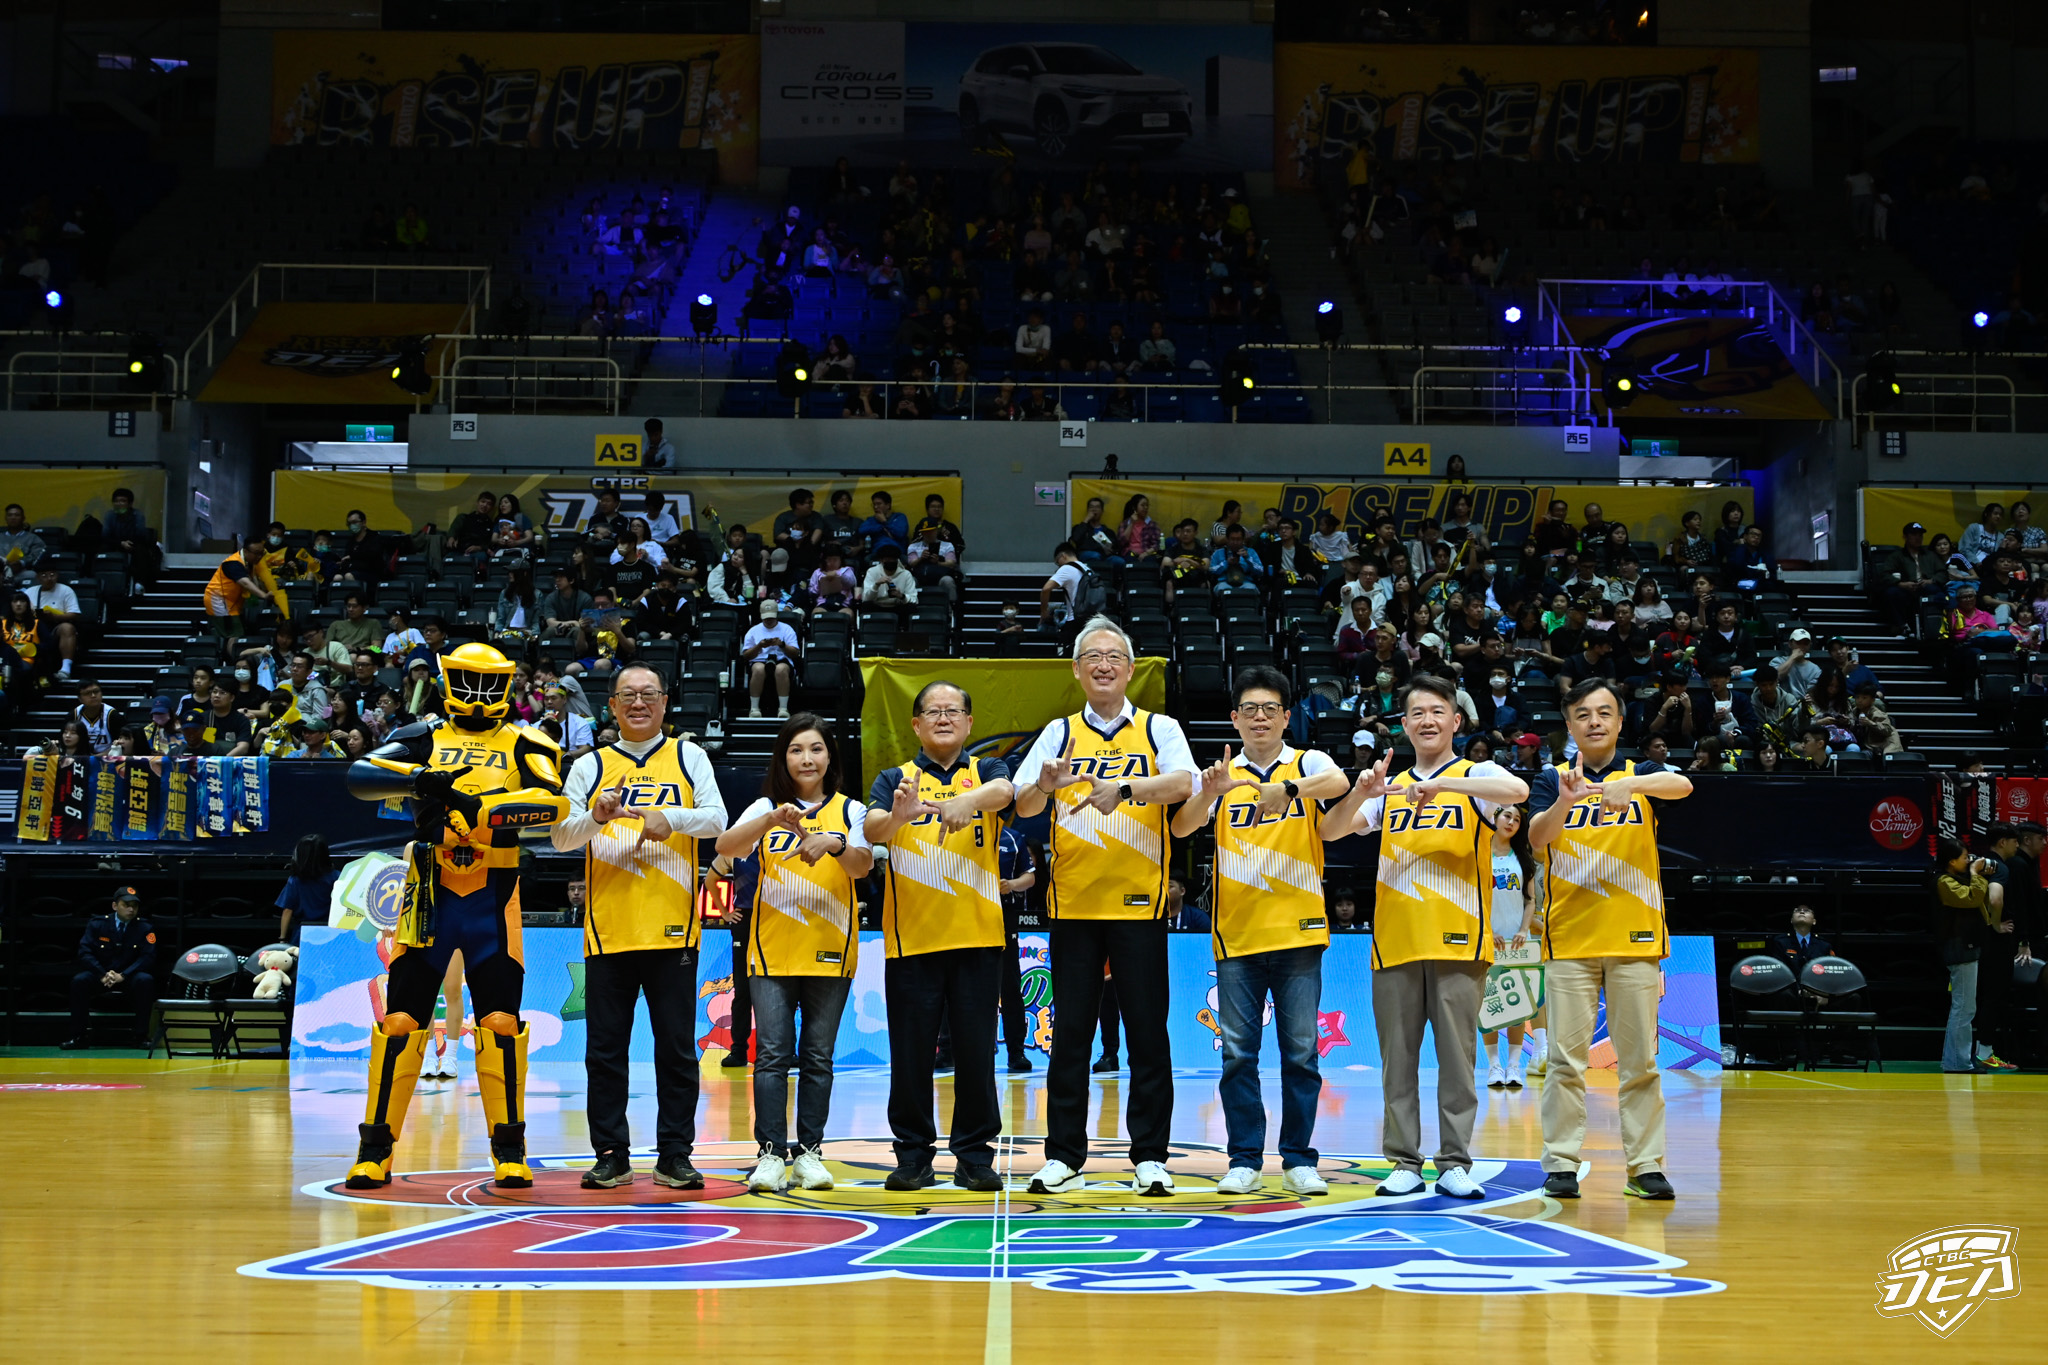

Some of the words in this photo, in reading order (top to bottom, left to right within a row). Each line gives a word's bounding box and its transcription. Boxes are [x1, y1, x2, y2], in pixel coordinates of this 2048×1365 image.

[781, 26, 825, 35] TOYOTA
[814, 71, 897, 82] COROLLA
[555, 57, 718, 148] UP!
[780, 85, 934, 101] CROSS
[1553, 66, 1716, 163] UP!
[452, 420, 476, 433] 西3
[1061, 427, 1085, 440] 西4
[1565, 432, 1589, 444] 西5
[597, 442, 638, 463] A3
[1386, 447, 1428, 468] A4
[591, 477, 650, 490] CTBC
[438, 747, 509, 771] DEA
[1095, 747, 1123, 757] CTBC
[1069, 753, 1151, 779] DEA
[25, 776, 46, 830] 謝亞軒
[128, 767, 149, 833] 謝亞軒
[243, 772, 263, 827] 謝亞軒
[1877, 801, 1905, 815] We
[64, 805, 83, 820] 6
[505, 811, 552, 824] NTPC
[1388, 804, 1465, 834] DEA
[1894, 812, 1910, 823] are
[973, 824, 985, 849] 9
[1870, 816, 1924, 839] Family
[1938, 819, 1957, 840] 24
[1018, 914, 1041, 926] POSS.
[262, 1208, 1645, 1276] DEA
